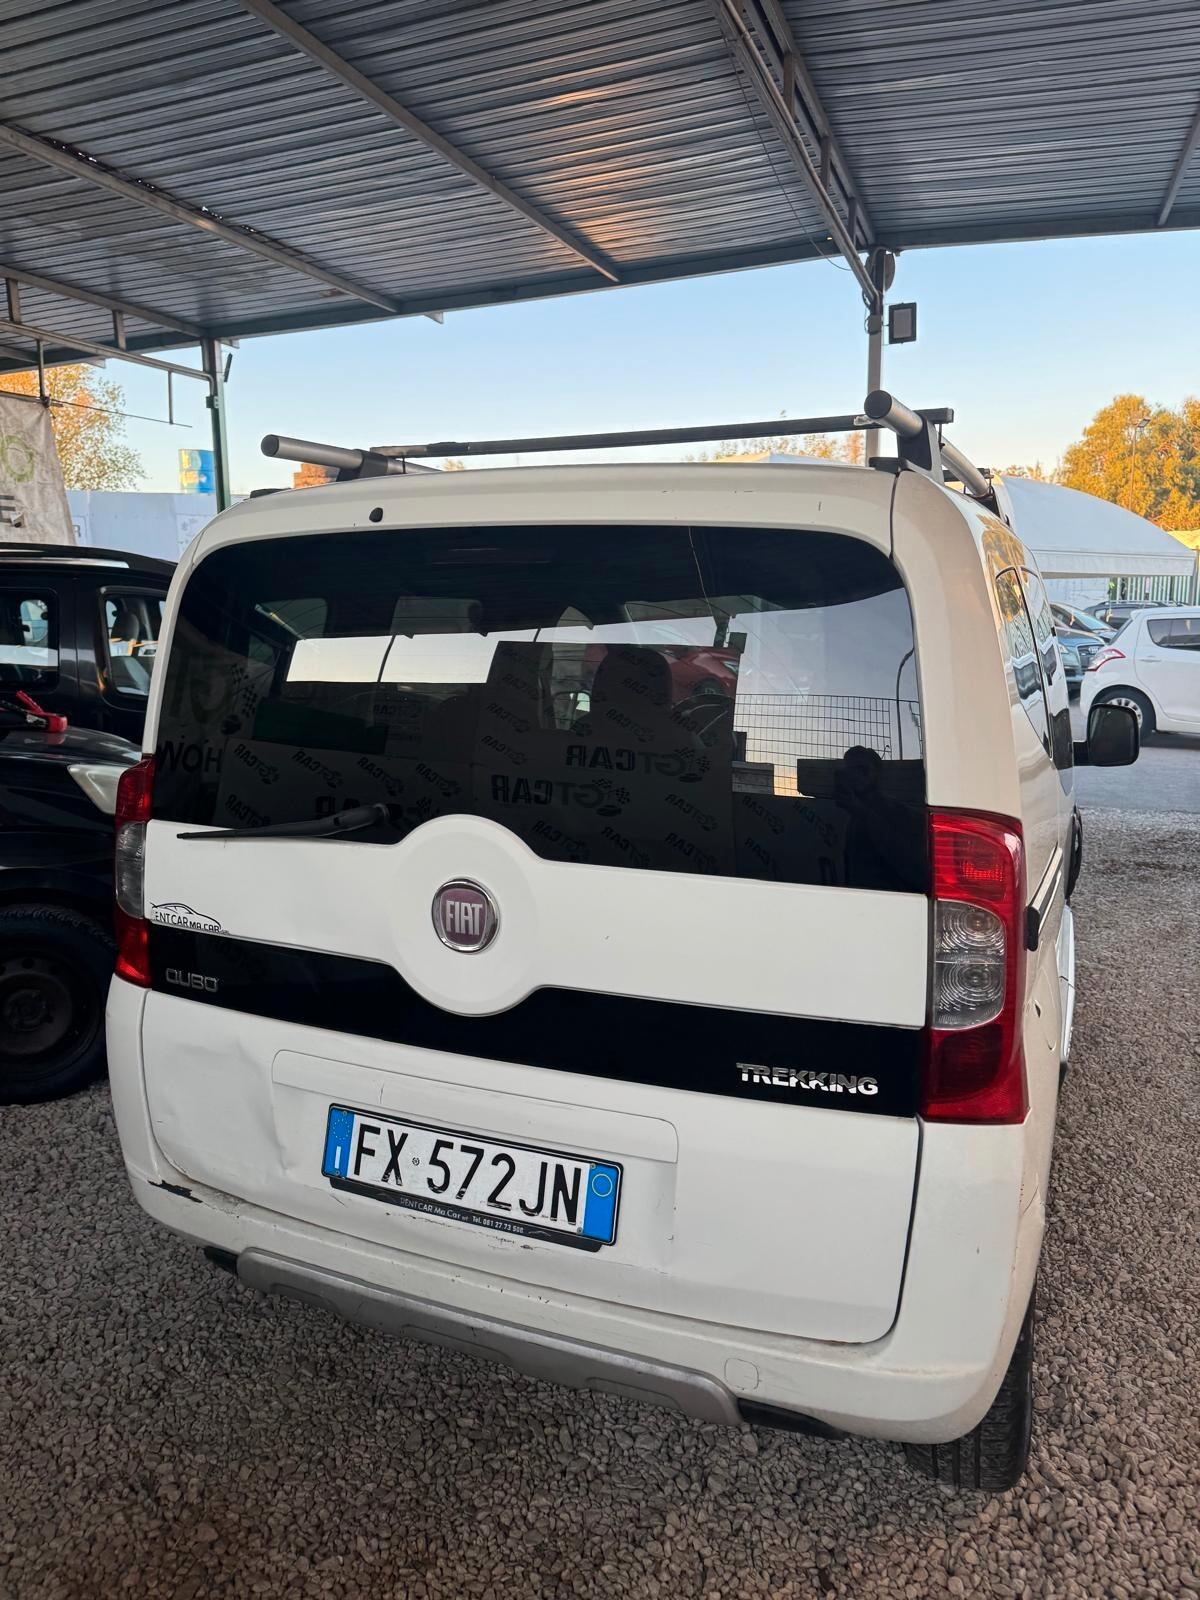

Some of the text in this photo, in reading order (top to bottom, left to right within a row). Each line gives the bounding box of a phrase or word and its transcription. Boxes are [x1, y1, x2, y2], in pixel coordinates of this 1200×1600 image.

[445, 900, 483, 935] FIAT
[165, 968, 218, 993] QUBO
[735, 1062, 878, 1096] TREKKING
